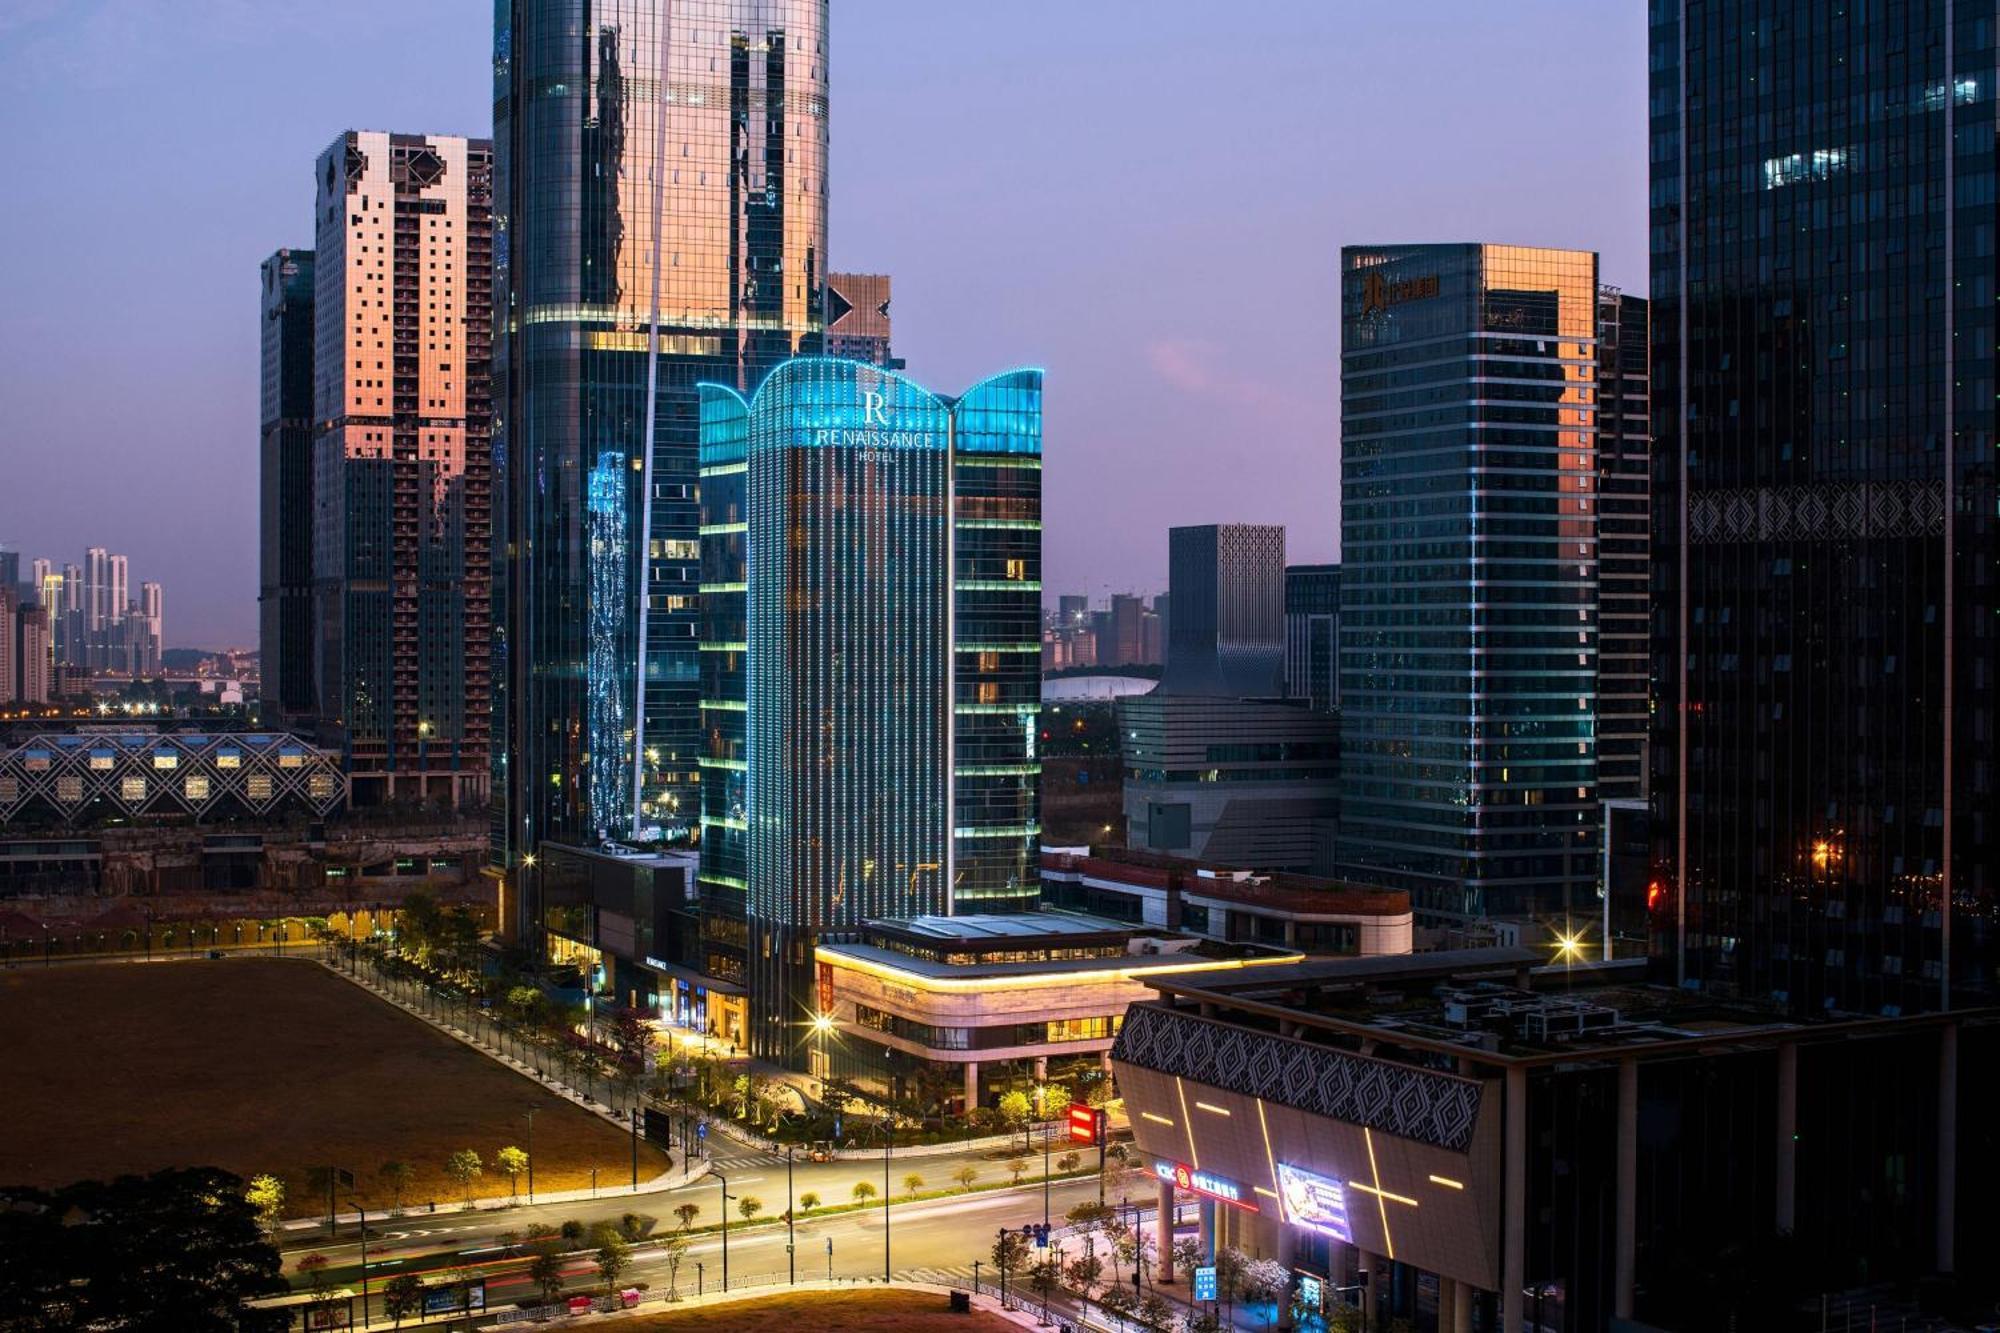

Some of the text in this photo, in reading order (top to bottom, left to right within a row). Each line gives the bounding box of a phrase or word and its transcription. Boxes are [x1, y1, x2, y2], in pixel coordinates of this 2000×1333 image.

[864, 391, 890, 425] R
[816, 429, 933, 448] RENAISSANCE
[859, 451, 895, 463] HOTEL
